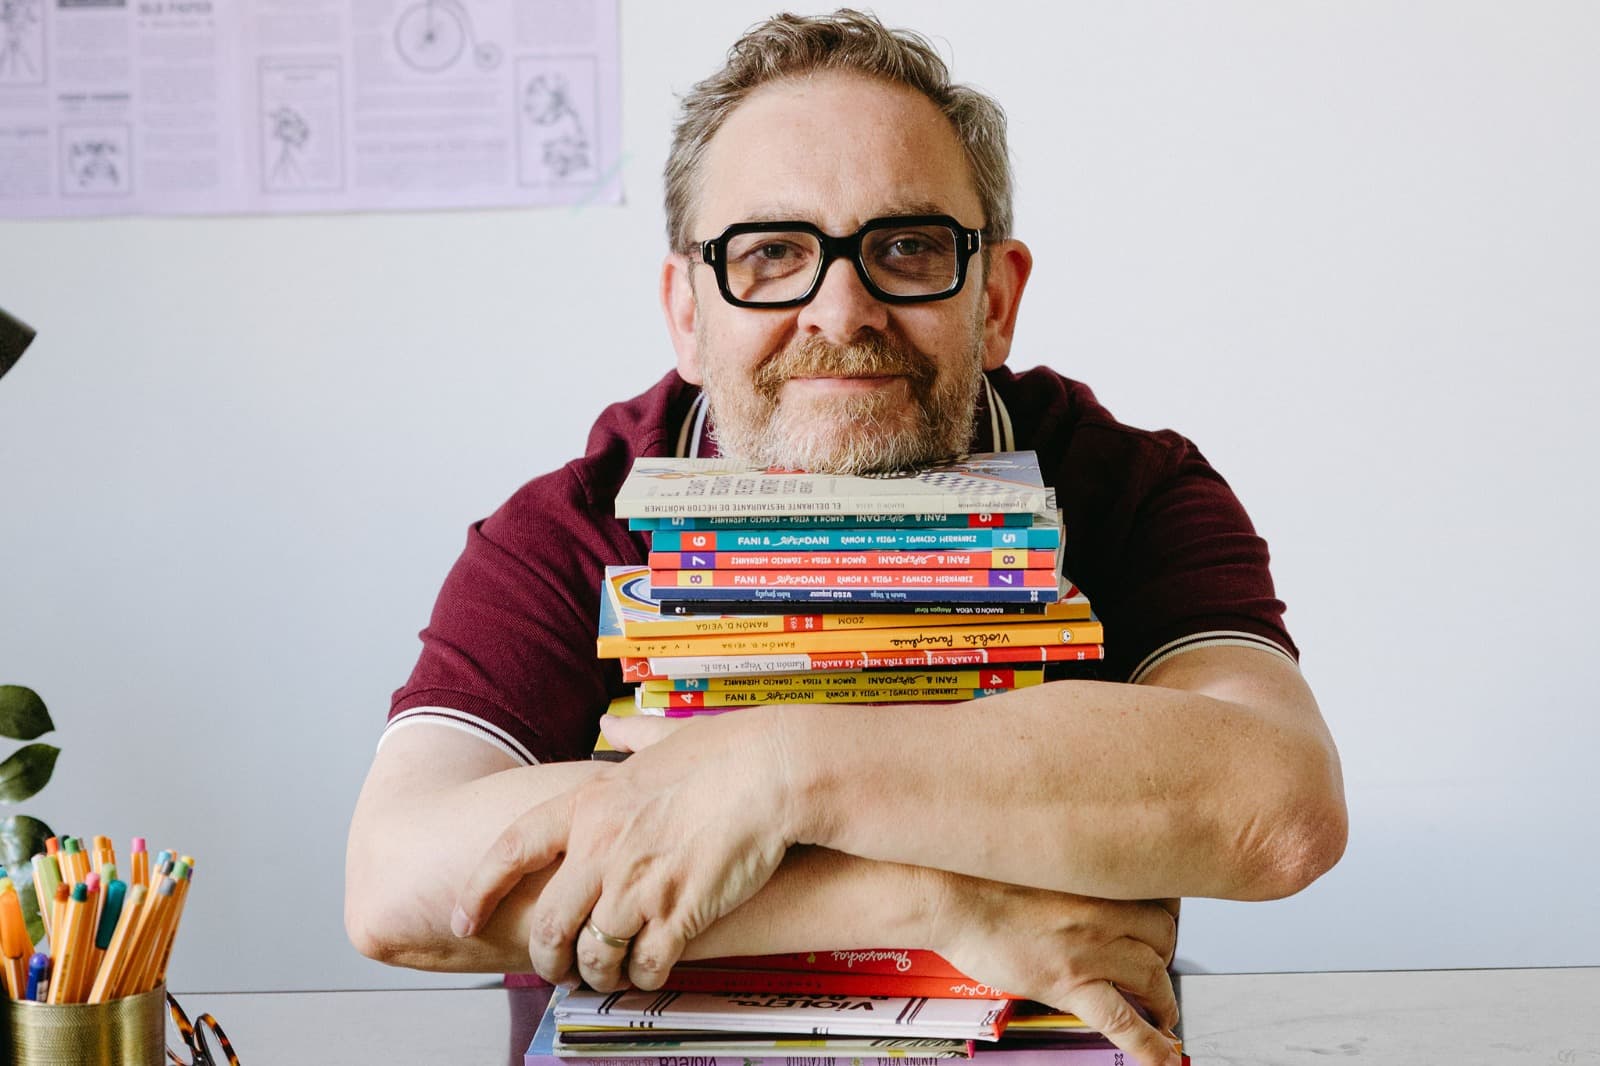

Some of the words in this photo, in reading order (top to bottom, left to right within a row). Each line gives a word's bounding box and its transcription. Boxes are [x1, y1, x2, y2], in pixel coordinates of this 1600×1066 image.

[644, 506, 685, 514] MÓRTIMER
[687, 504, 718, 513] HÉCTOR
[789, 503, 829, 511] DELIRANTE
[692, 536, 706, 546] 6
[738, 537, 761, 545] FANI
[764, 537, 770, 545] &
[841, 536, 865, 545] RAMÓN
[876, 536, 896, 544] VEIGA
[906, 536, 936, 544] IGNACIO
[1002, 534, 1016, 544] 5
[692, 556, 706, 566] 7
[771, 557, 801, 565] IGNACIO
[811, 556, 831, 564] VEIGA
[843, 556, 866, 565] RAMÓN
[938, 556, 945, 564] &
[947, 556, 970, 564] FANI
[1003, 556, 1015, 565] 8
[690, 576, 702, 584] 8
[734, 576, 757, 584] FANI
[759, 576, 766, 584] &
[837, 576, 863, 585] RAMÓN
[873, 576, 893, 584] VEIGA
[902, 576, 933, 584] IGNACIO
[999, 574, 1012, 584] 7
[838, 616, 865, 625] ZOOM
[736, 622, 769, 630] RAMÓN
[890, 634, 953, 647] Parapluie
[963, 632, 1010, 647] Violeta
[776, 660, 805, 670] Ramón
[812, 660, 844, 669] ARAÑAS
[906, 657, 925, 665] LLES
[701, 664, 711, 673] R.
[713, 663, 730, 673] Iván
[739, 660, 761, 672] Veiga
[764, 662, 775, 671] D.
[686, 679, 699, 688] 3
[926, 676, 933, 684] &
[936, 676, 958, 684] FANI
[990, 674, 1003, 685] 4
[726, 693, 747, 701] FANI
[750, 693, 757, 701] &
[890, 689, 919, 697] IGNACIO
[680, 694, 694, 704] 4
[832, 950, 912, 971] Pernascochas
